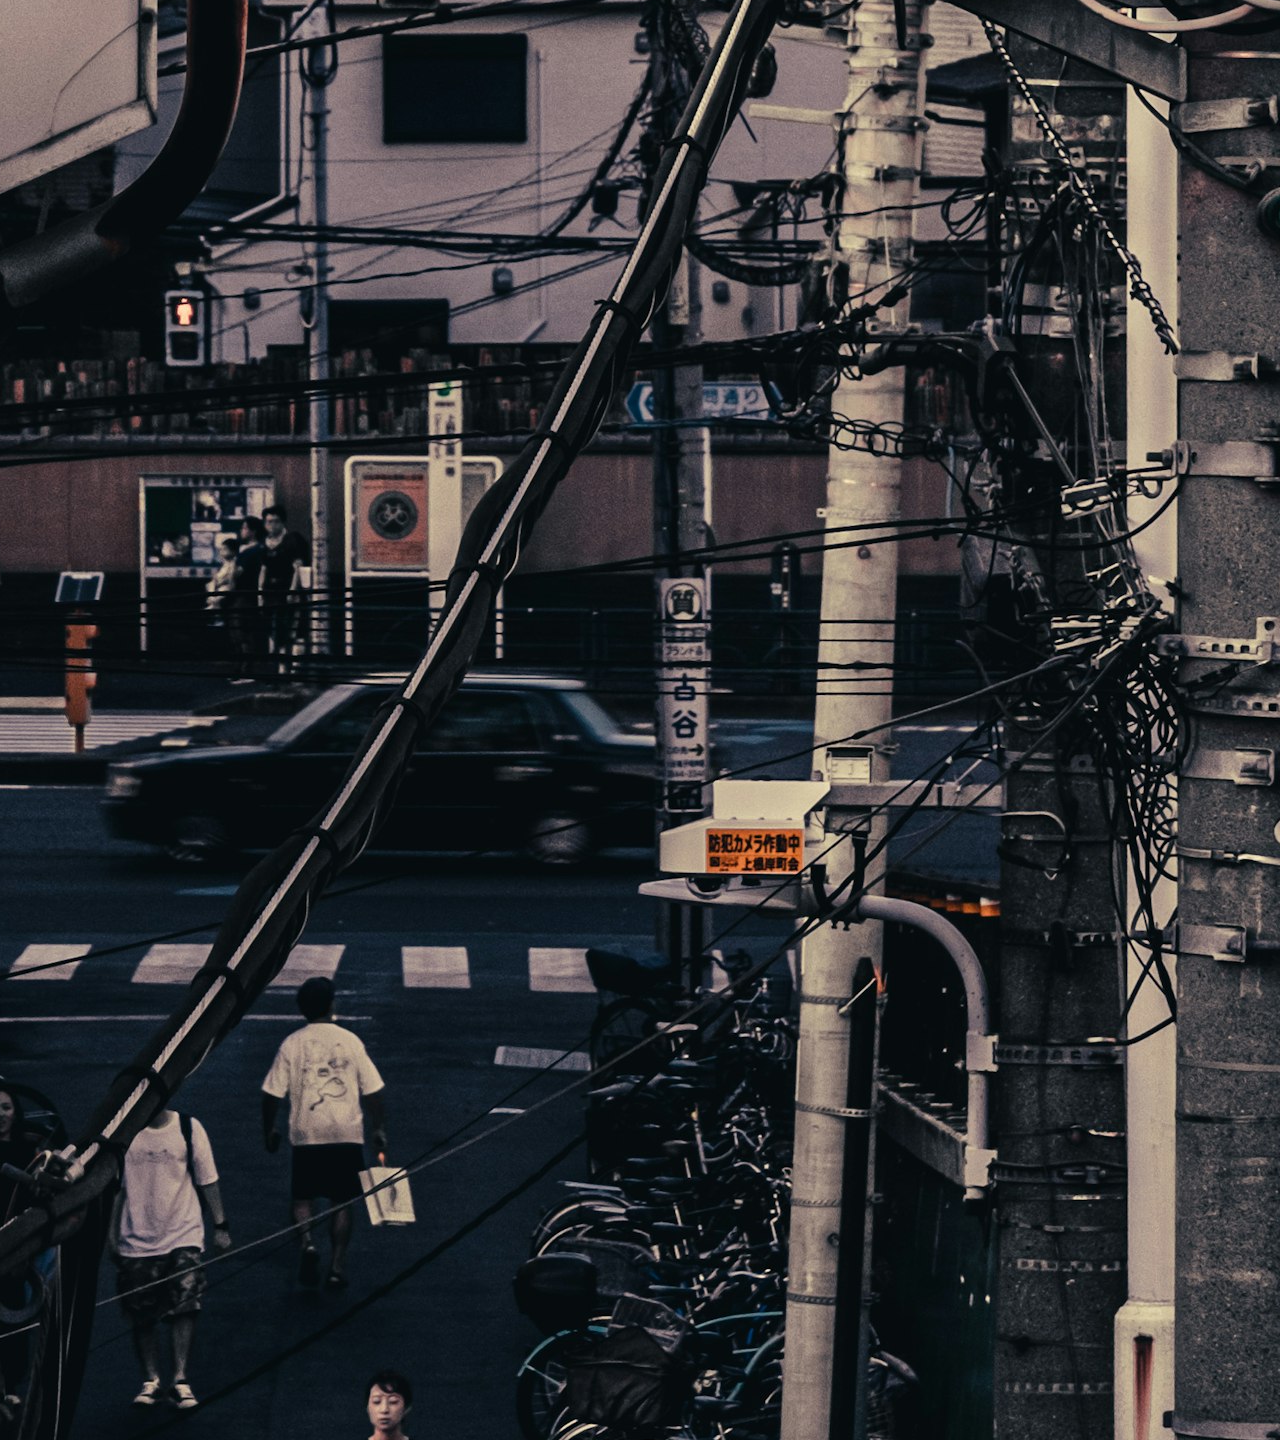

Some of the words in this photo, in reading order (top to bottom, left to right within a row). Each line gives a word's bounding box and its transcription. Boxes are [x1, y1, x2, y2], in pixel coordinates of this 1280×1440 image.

[671, 673, 699, 739] 古谷
[708, 834, 800, 854] 防犯カメラ作動中
